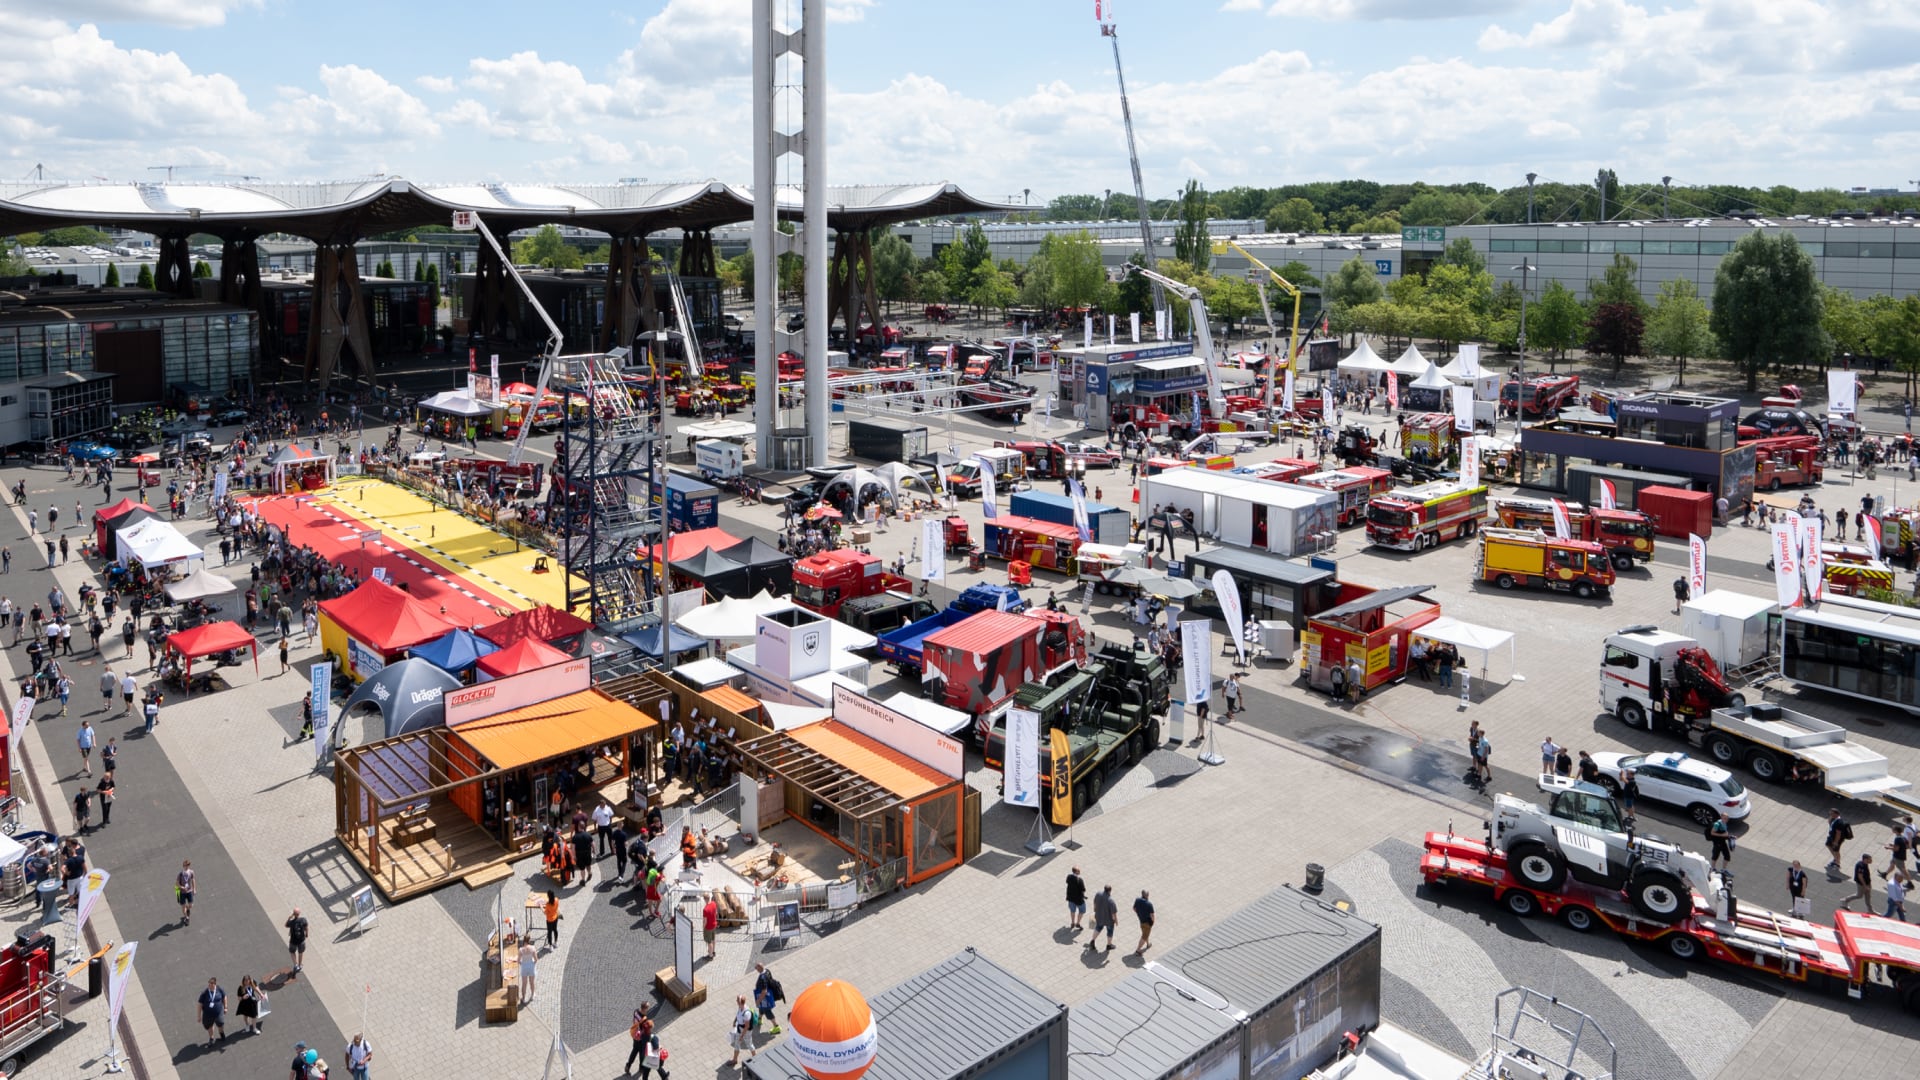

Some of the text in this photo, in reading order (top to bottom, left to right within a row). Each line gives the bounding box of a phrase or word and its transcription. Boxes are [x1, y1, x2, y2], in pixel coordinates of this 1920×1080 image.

[1378, 263, 1389, 272] 12
[1622, 404, 1658, 413] SCANIA
[564, 664, 585, 673] STIHL
[314, 668, 322, 711] BAUER
[372, 682, 390, 701] Dräger
[411, 686, 443, 704] Dräger
[451, 688, 496, 706] GLOCKZIN
[837, 692, 894, 724] VORFÜHRBEREICH
[937, 738, 959, 754] STIHL
